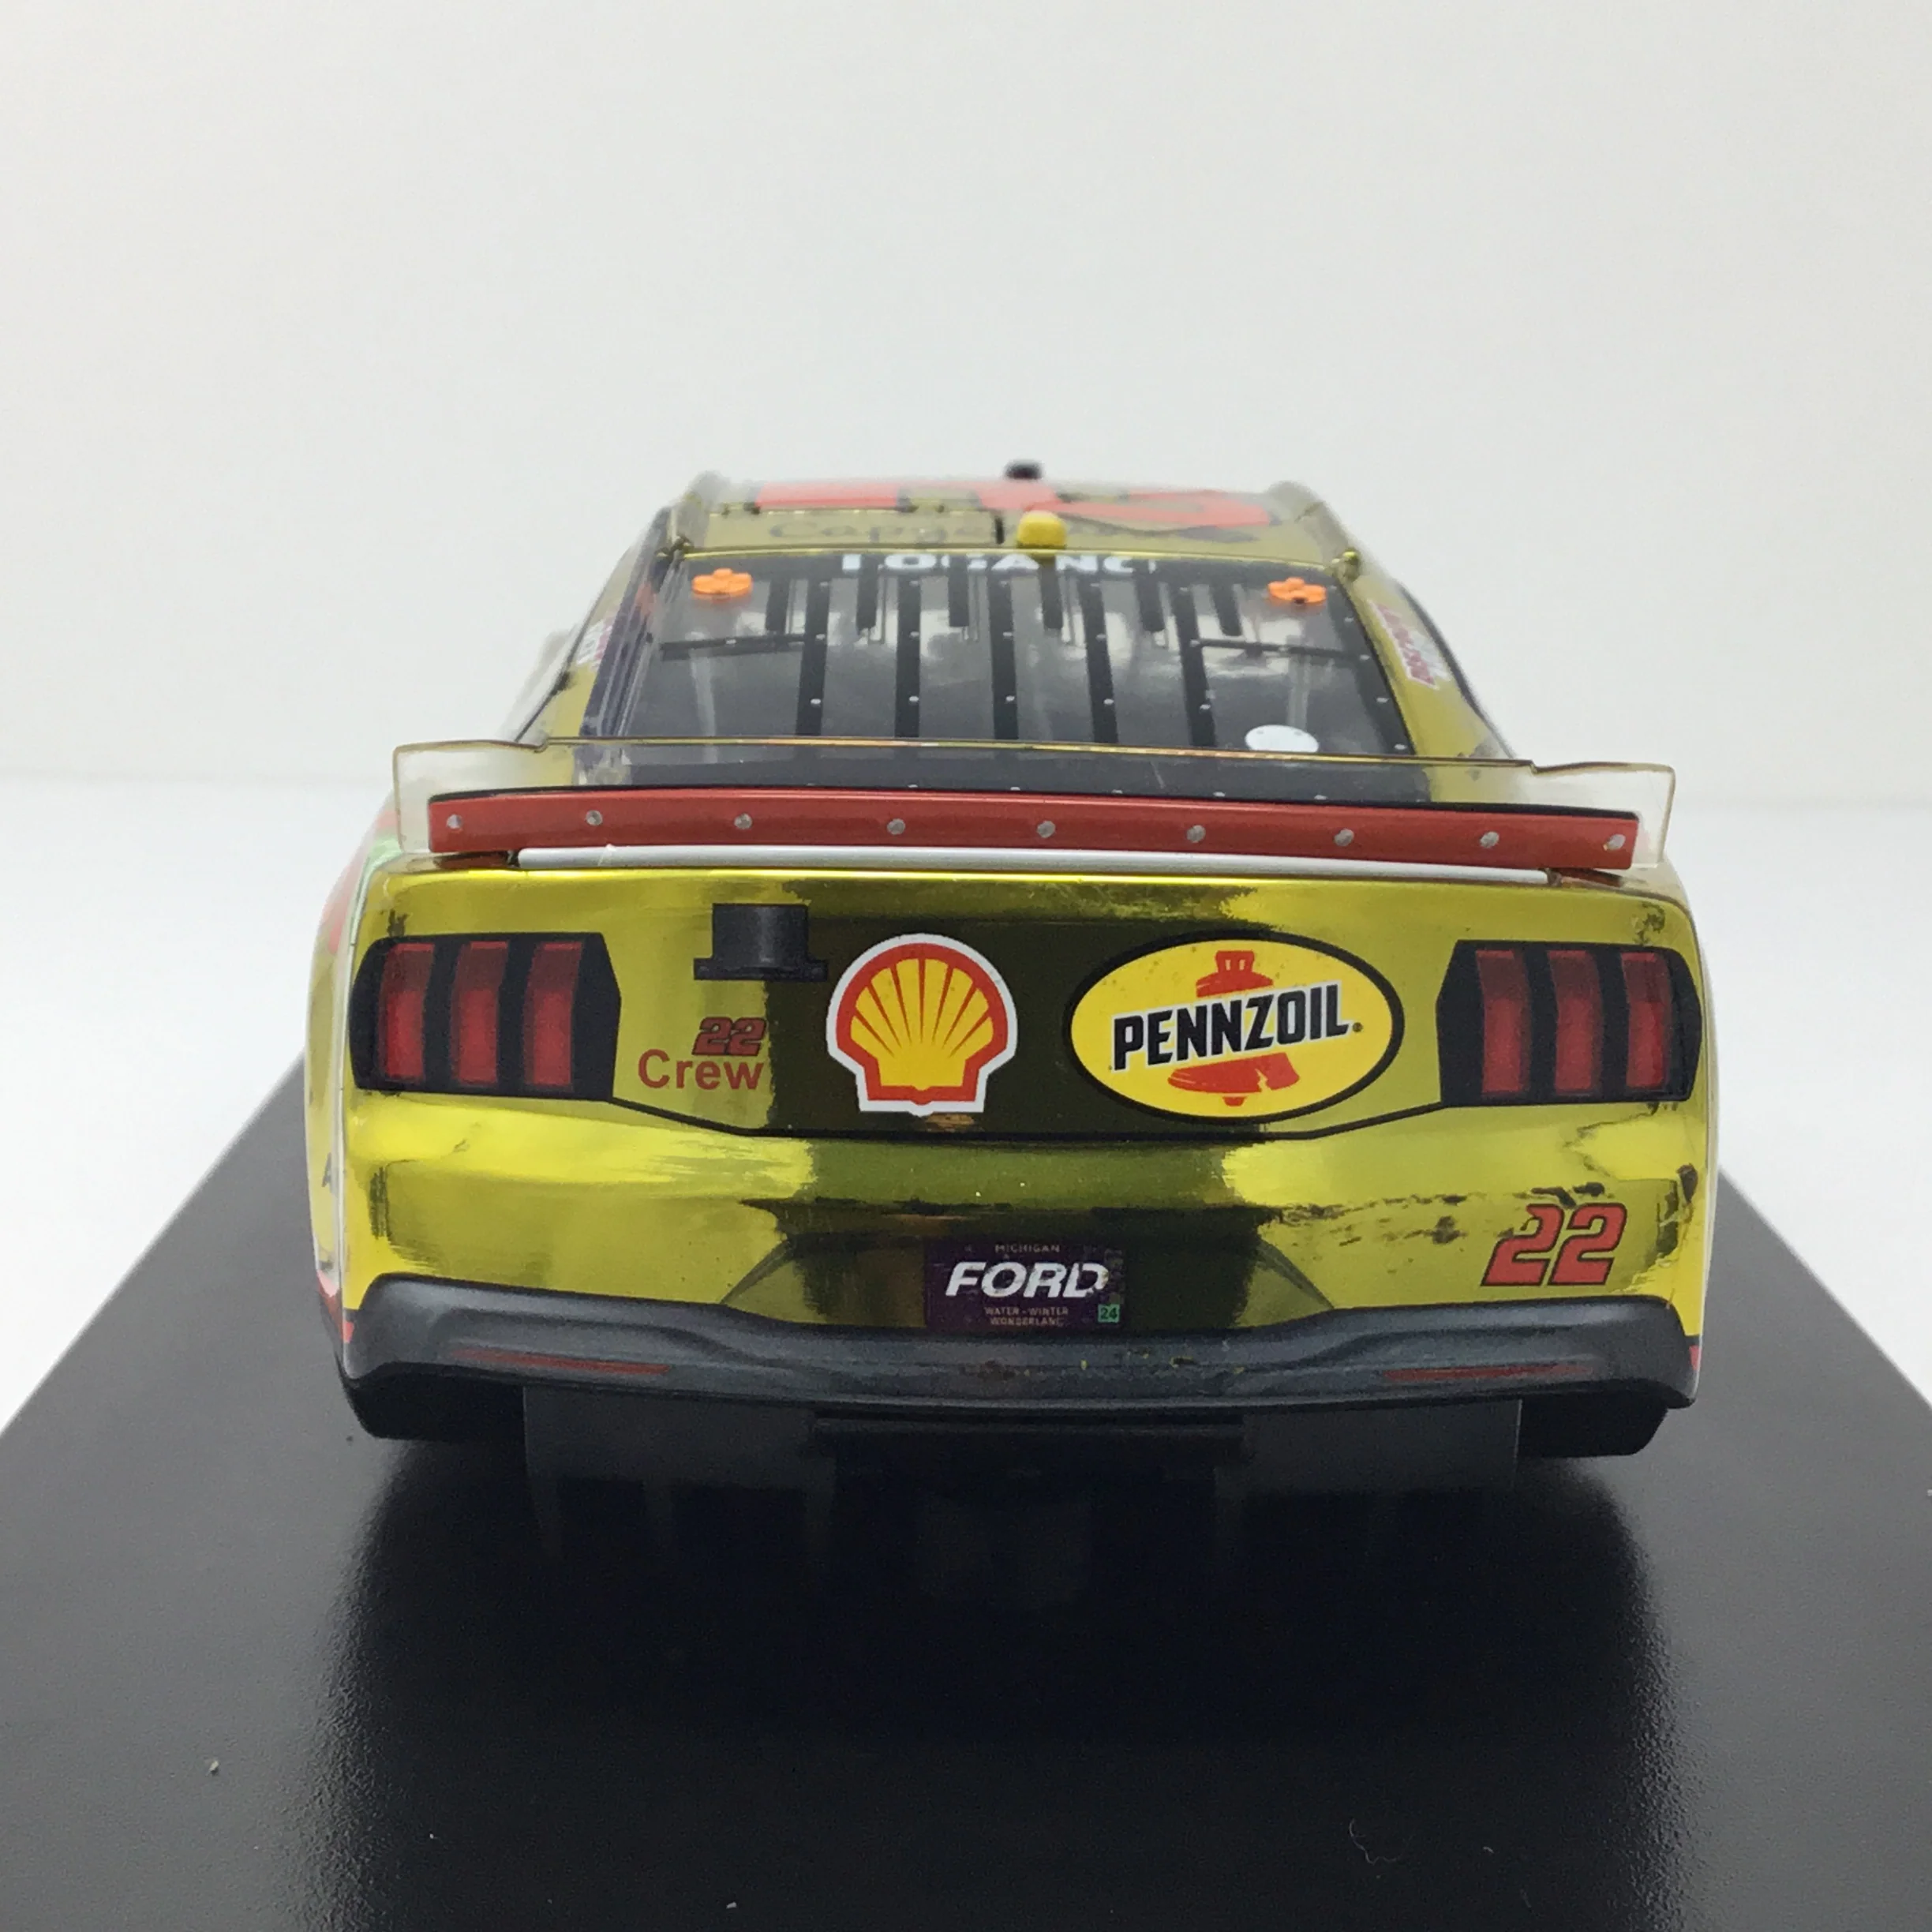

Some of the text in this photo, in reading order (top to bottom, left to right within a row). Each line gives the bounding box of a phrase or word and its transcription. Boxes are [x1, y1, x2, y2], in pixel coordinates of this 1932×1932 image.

[691, 1016, 766, 1056] 22
[638, 1048, 765, 1090] Crew
[994, 1243, 1061, 1253] MICHIGAN
[1481, 1202, 1627, 1286] 22
[945, 1261, 1109, 1298] FORD
[1100, 1307, 1117, 1320] 24
